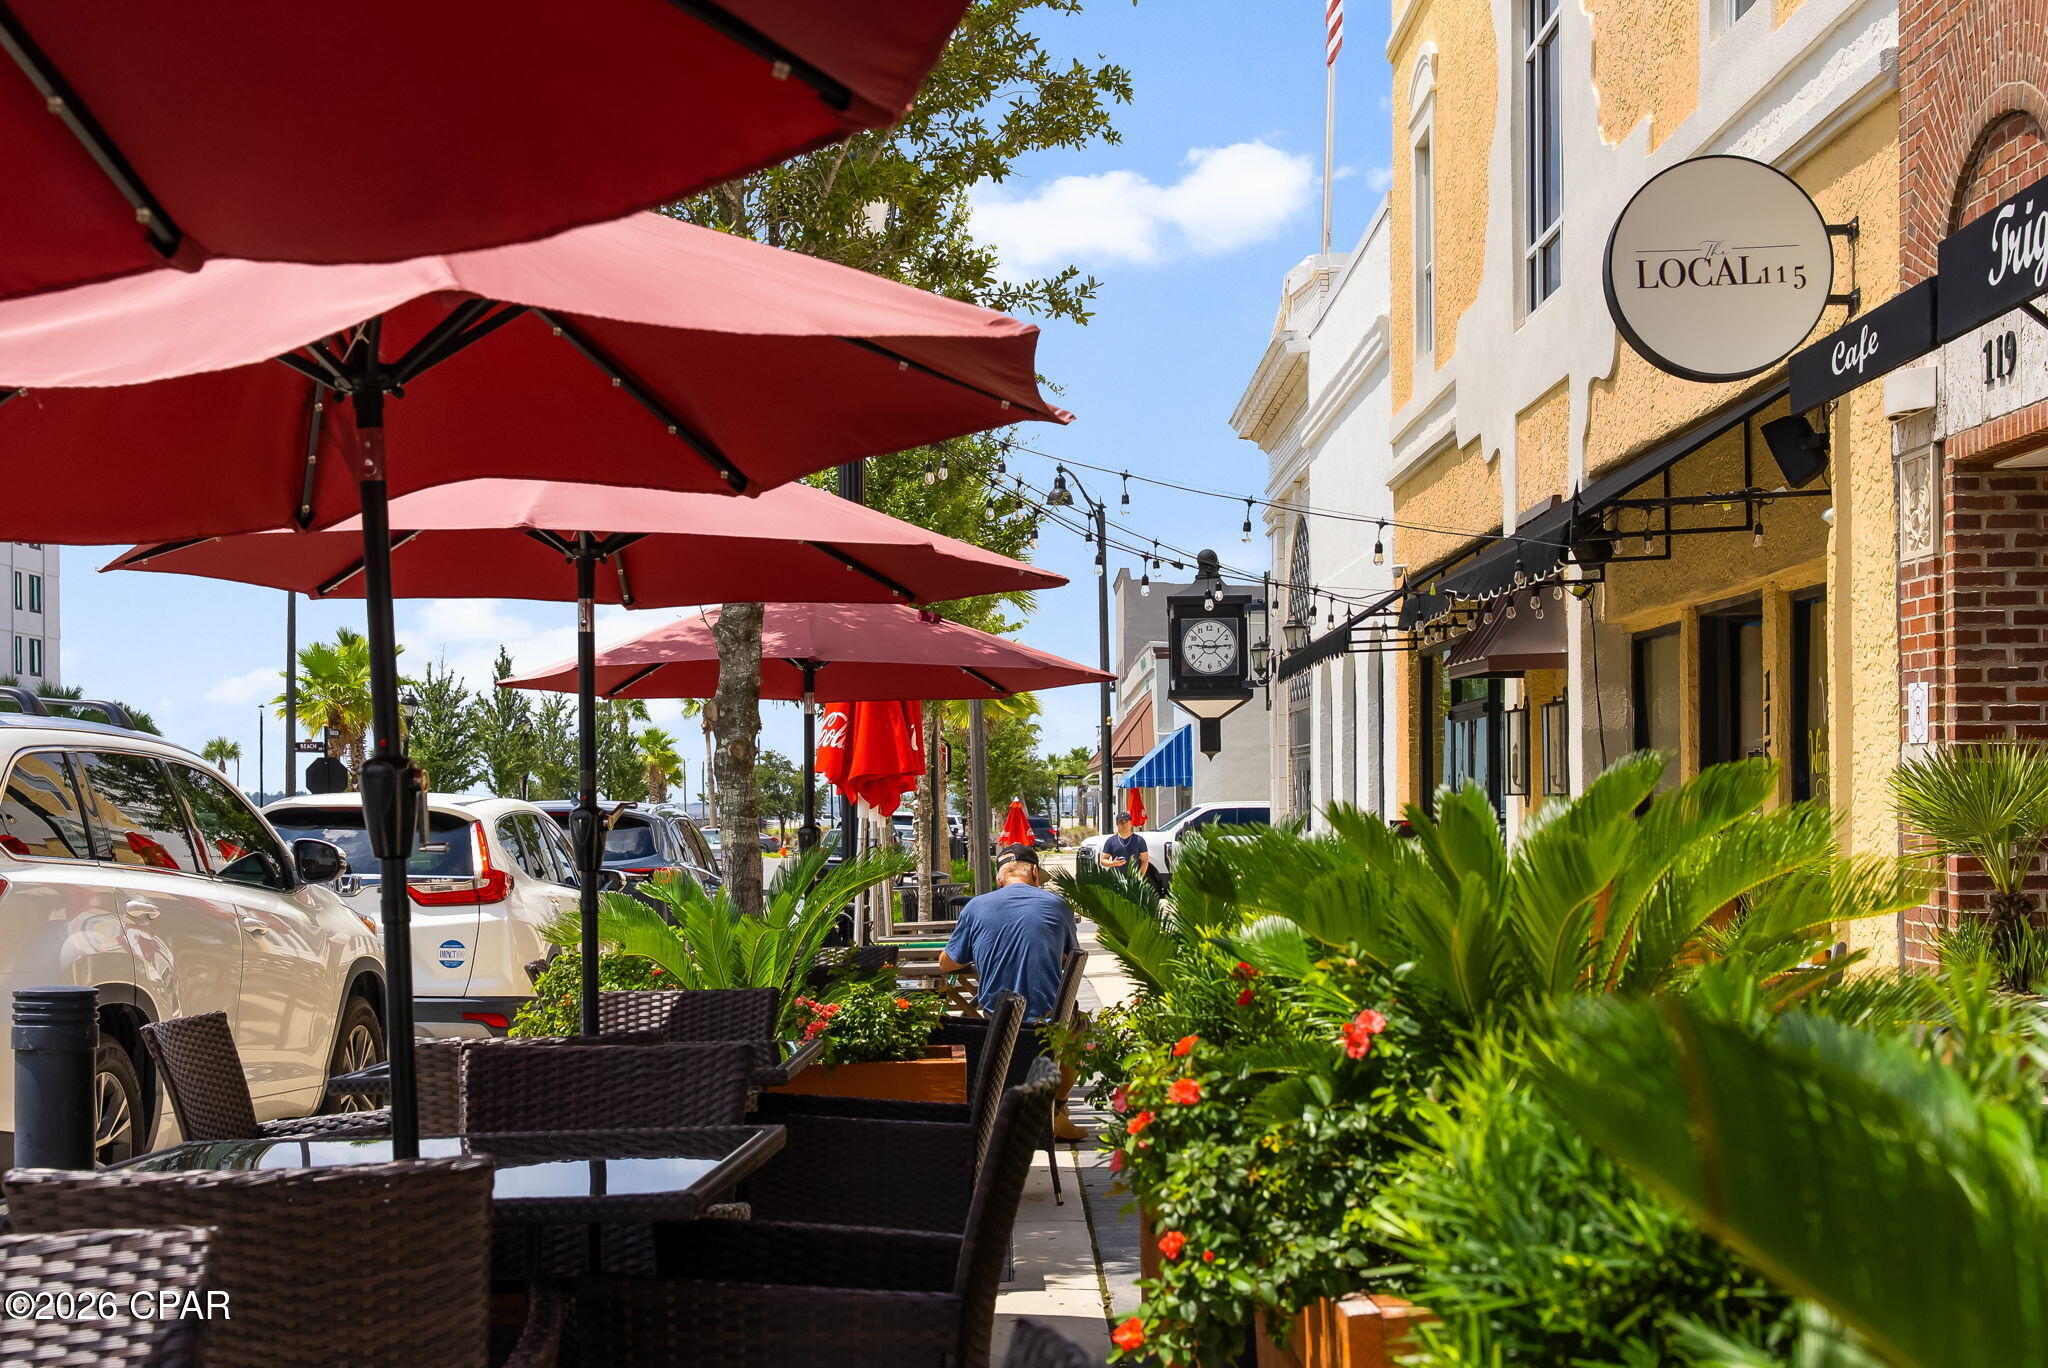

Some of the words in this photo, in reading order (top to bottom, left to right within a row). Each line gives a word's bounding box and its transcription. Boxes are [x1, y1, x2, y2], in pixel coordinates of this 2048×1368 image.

[1698, 240, 1728, 263] The
[1831, 324, 1880, 375] Cafe
[1982, 330, 2018, 385] 119
